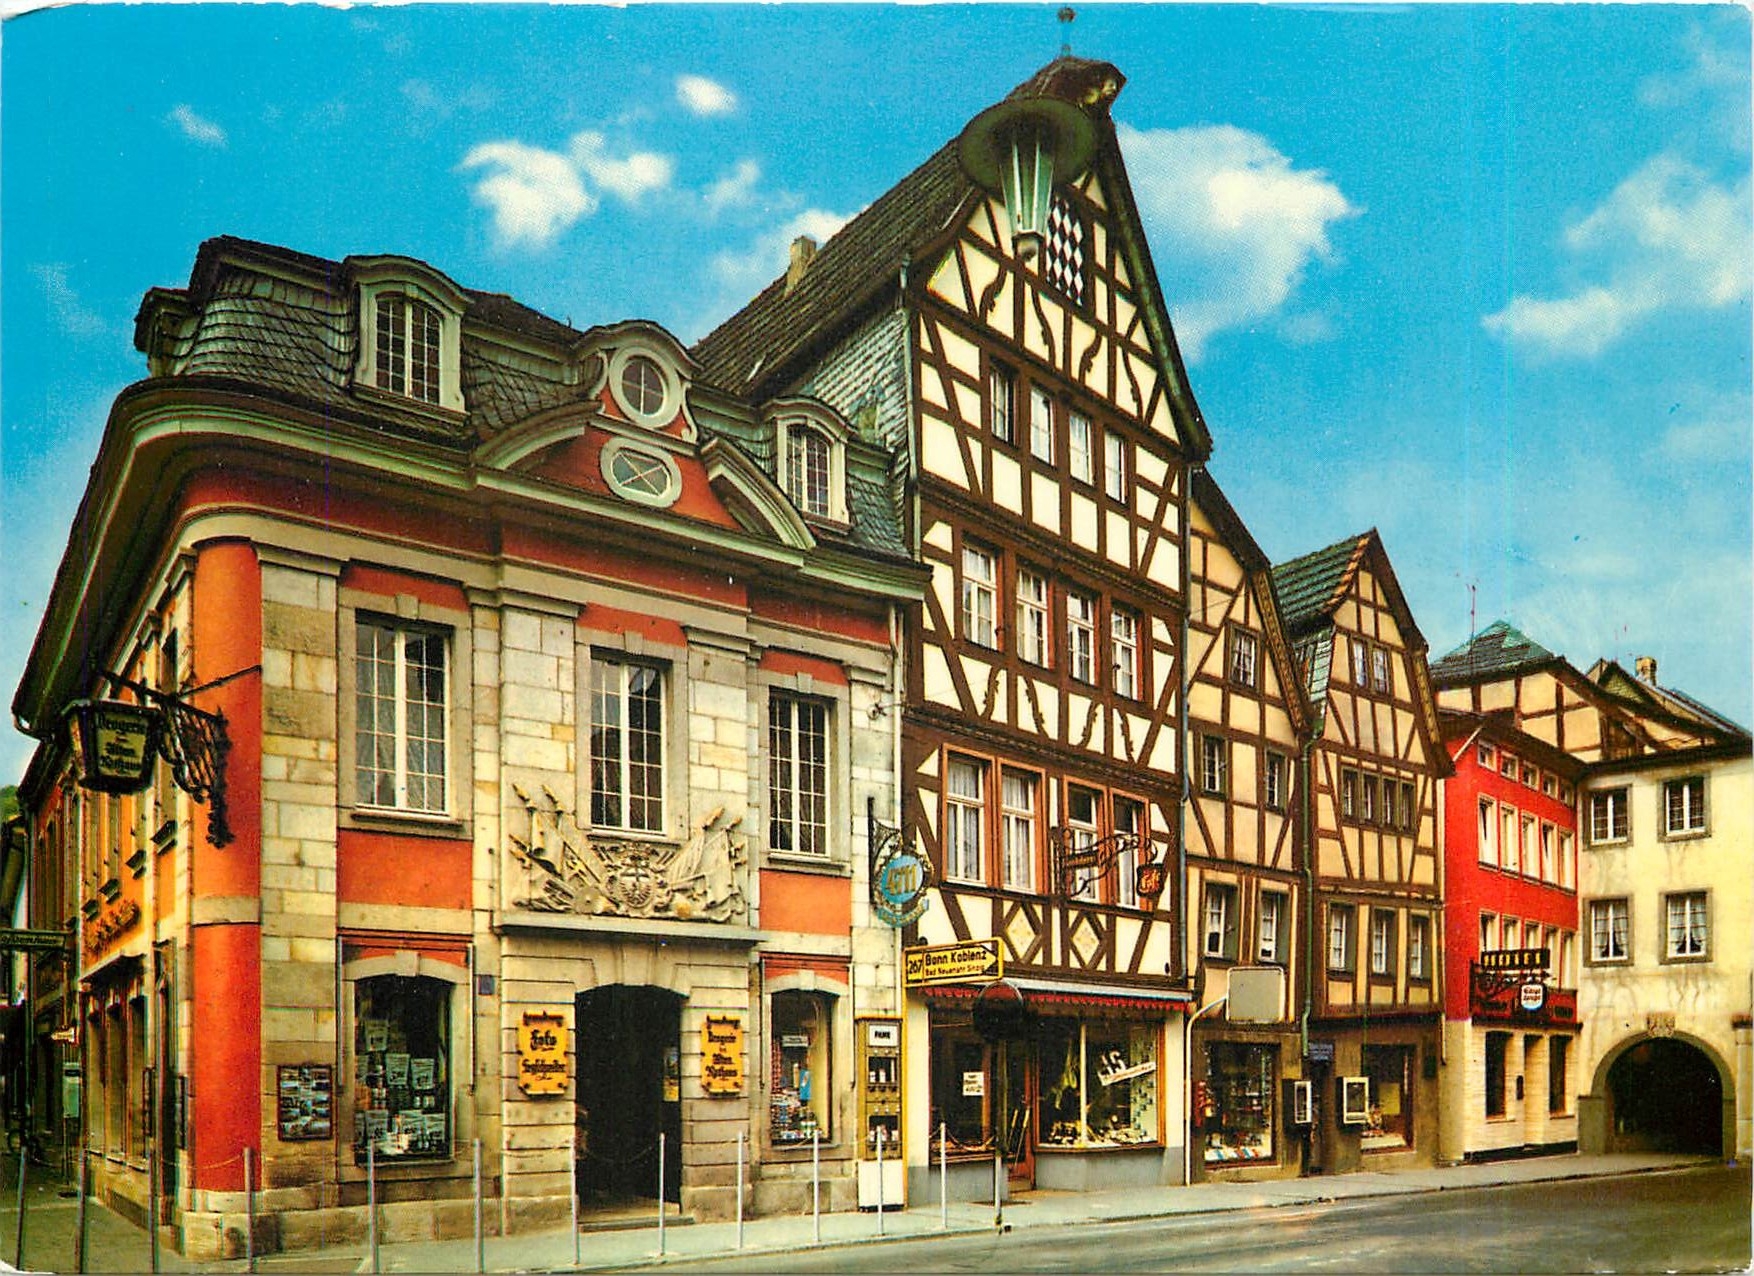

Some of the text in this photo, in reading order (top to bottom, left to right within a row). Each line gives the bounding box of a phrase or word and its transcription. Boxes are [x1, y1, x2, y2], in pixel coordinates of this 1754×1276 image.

[886, 864, 917, 896] 4711
[925, 953, 948, 966] Bonn
[950, 950, 987, 964] Koblenz
[530, 1029, 558, 1051] Foto
